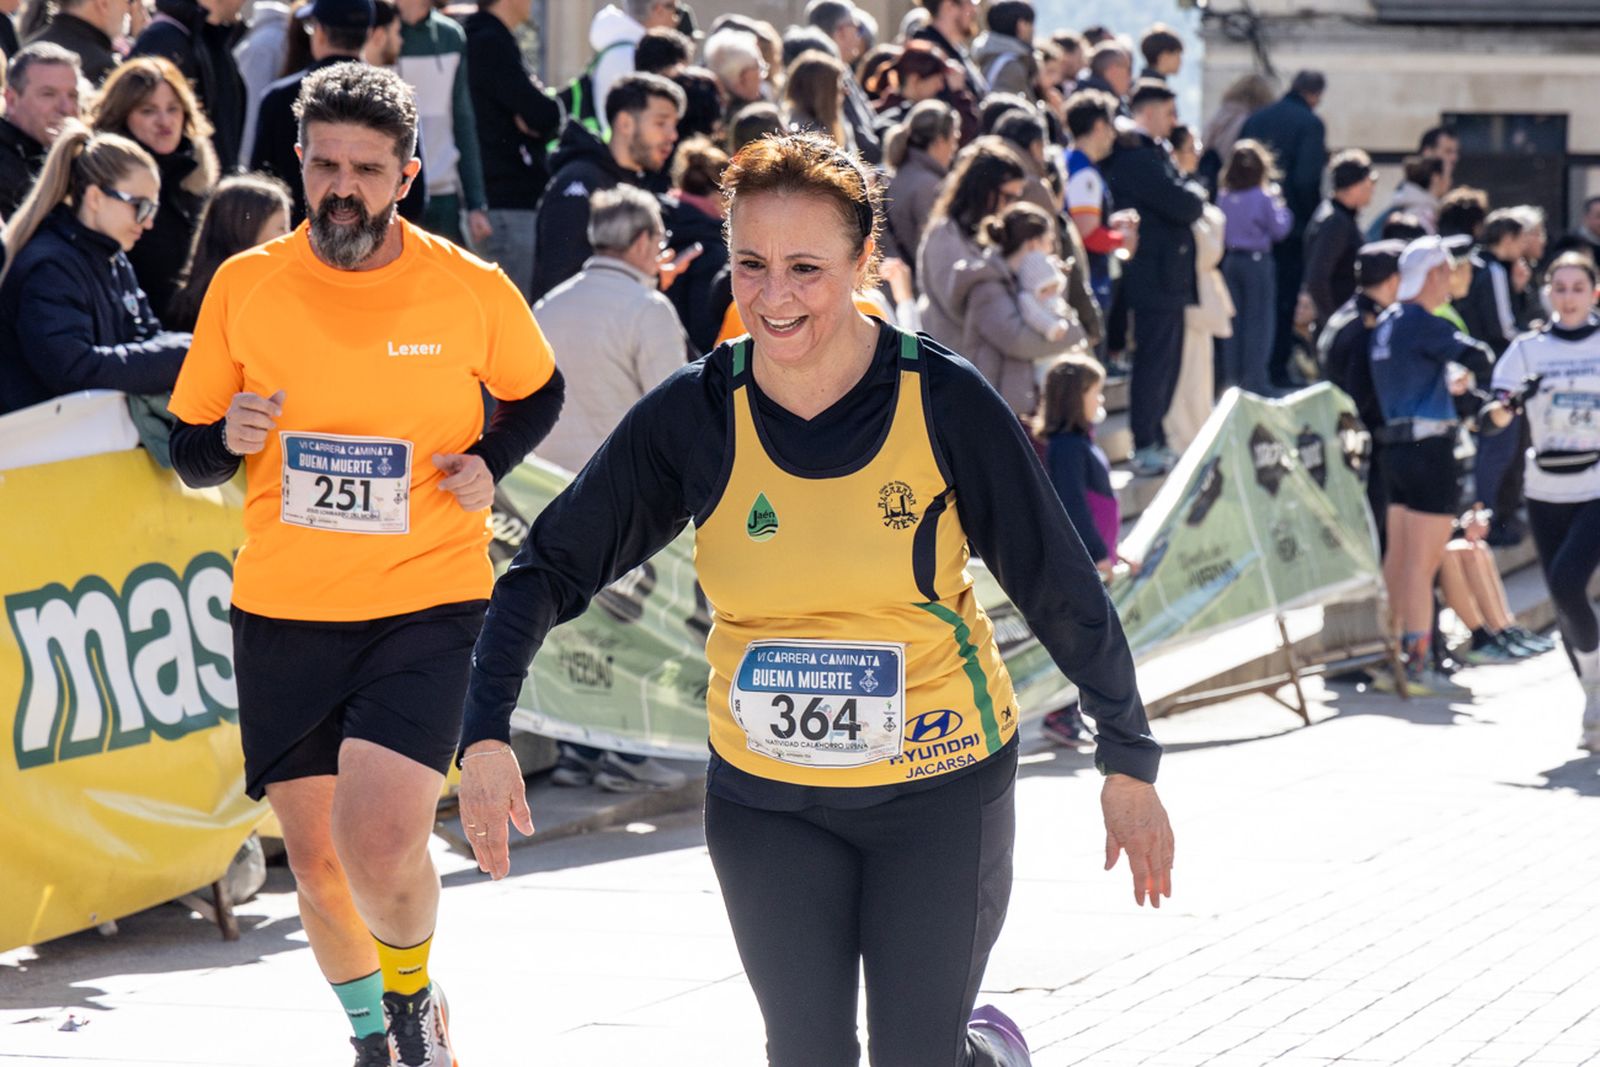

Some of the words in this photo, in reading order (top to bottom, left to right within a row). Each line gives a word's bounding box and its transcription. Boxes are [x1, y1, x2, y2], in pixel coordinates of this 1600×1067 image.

[308, 441, 346, 455] CARRERA
[347, 446, 394, 457] CAMINATA
[299, 453, 329, 471] BUENA
[331, 458, 373, 474] MUERTE
[314, 475, 371, 512] 251
[748, 510, 776, 529] Jaén
[757, 652, 766, 663] VI
[767, 651, 817, 665] CARRERA
[820, 654, 880, 667] CAMINATA
[752, 668, 794, 689] BUENA
[798, 671, 853, 690] MUERTE
[770, 694, 862, 741] 364
[765, 738, 799, 749] NATIVIDAD
[905, 753, 978, 779] JACARSA
